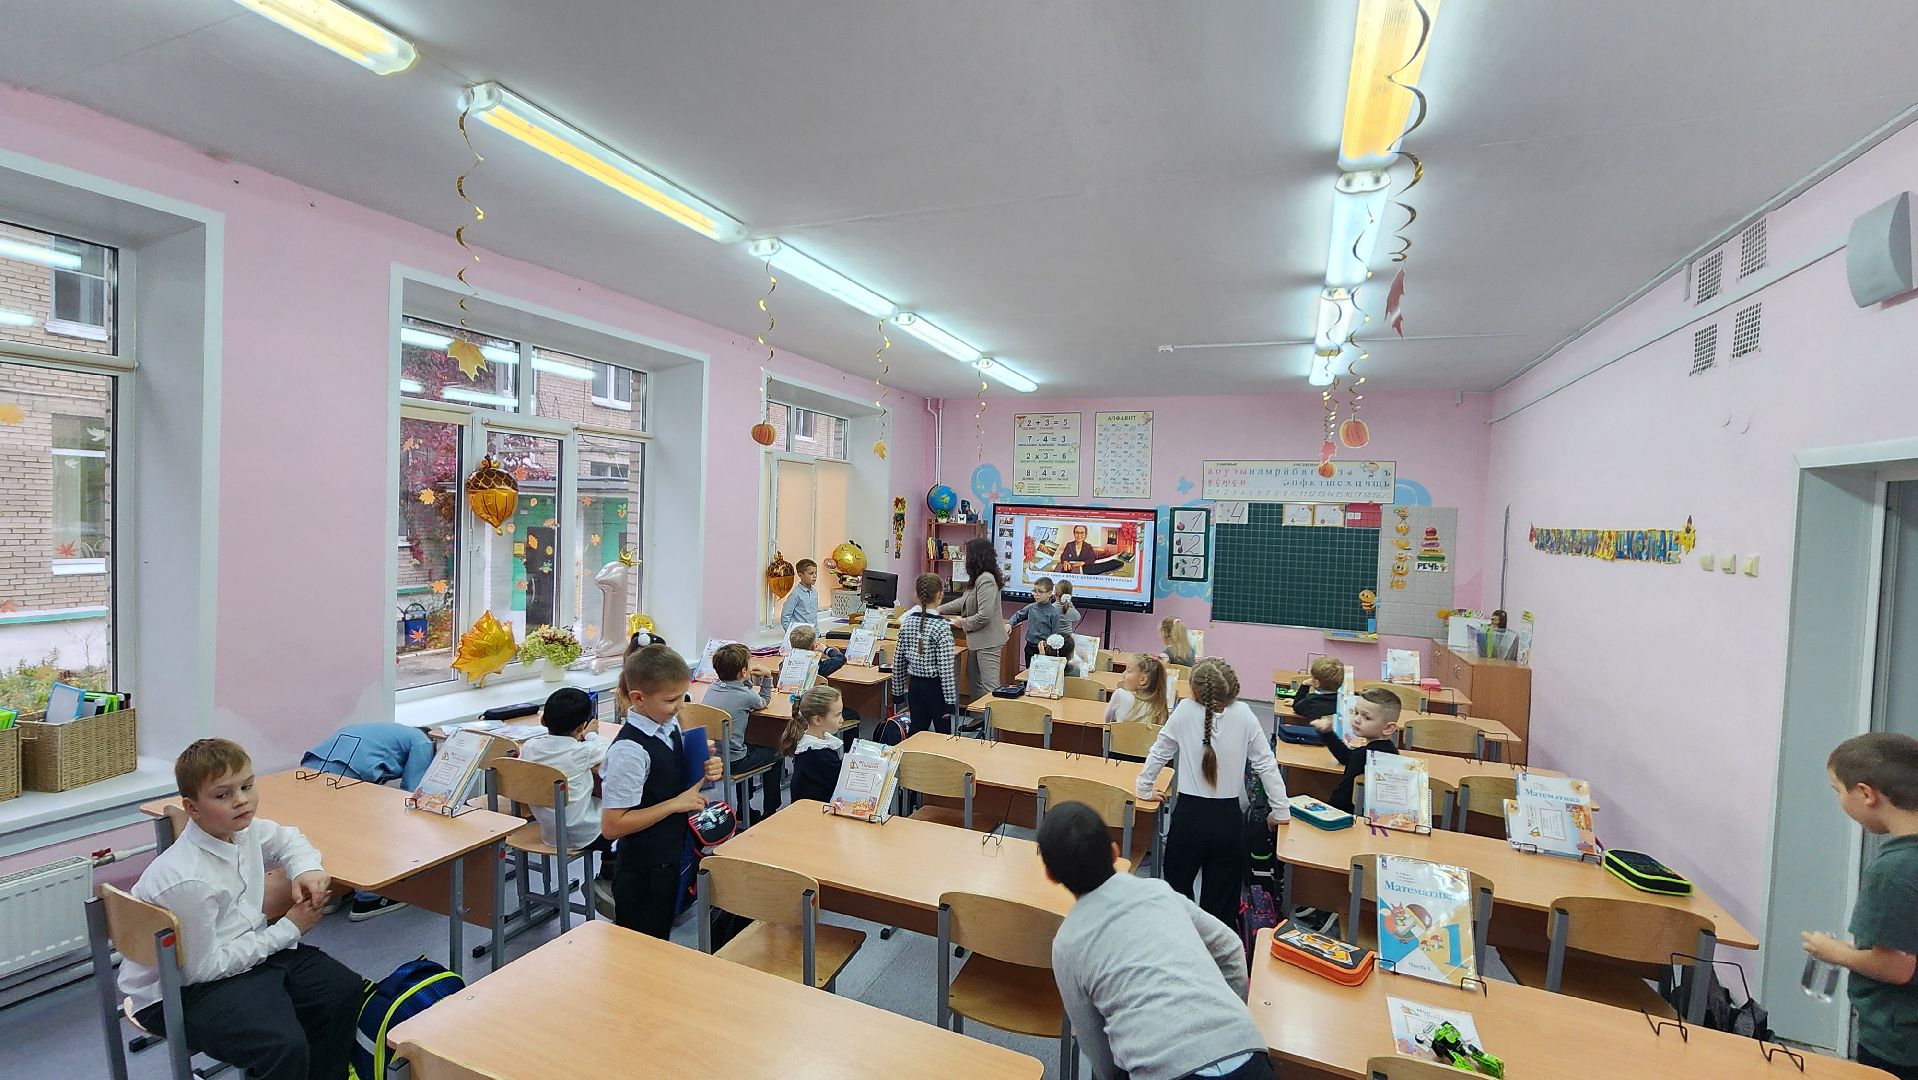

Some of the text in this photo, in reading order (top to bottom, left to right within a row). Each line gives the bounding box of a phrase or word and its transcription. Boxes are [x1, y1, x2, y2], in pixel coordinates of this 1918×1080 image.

[1063, 418, 1068, 426] 5
[1191, 511, 1202, 531] 1
[1231, 502, 1246, 522] 4
[1185, 534, 1200, 554] 2
[1190, 558, 1201, 576] 3
[1417, 562, 1440, 571] РЕЧЬ
[1525, 787, 1580, 803] Математика
[1384, 880, 1456, 900] Математика
[1441, 923, 1470, 969] 1
